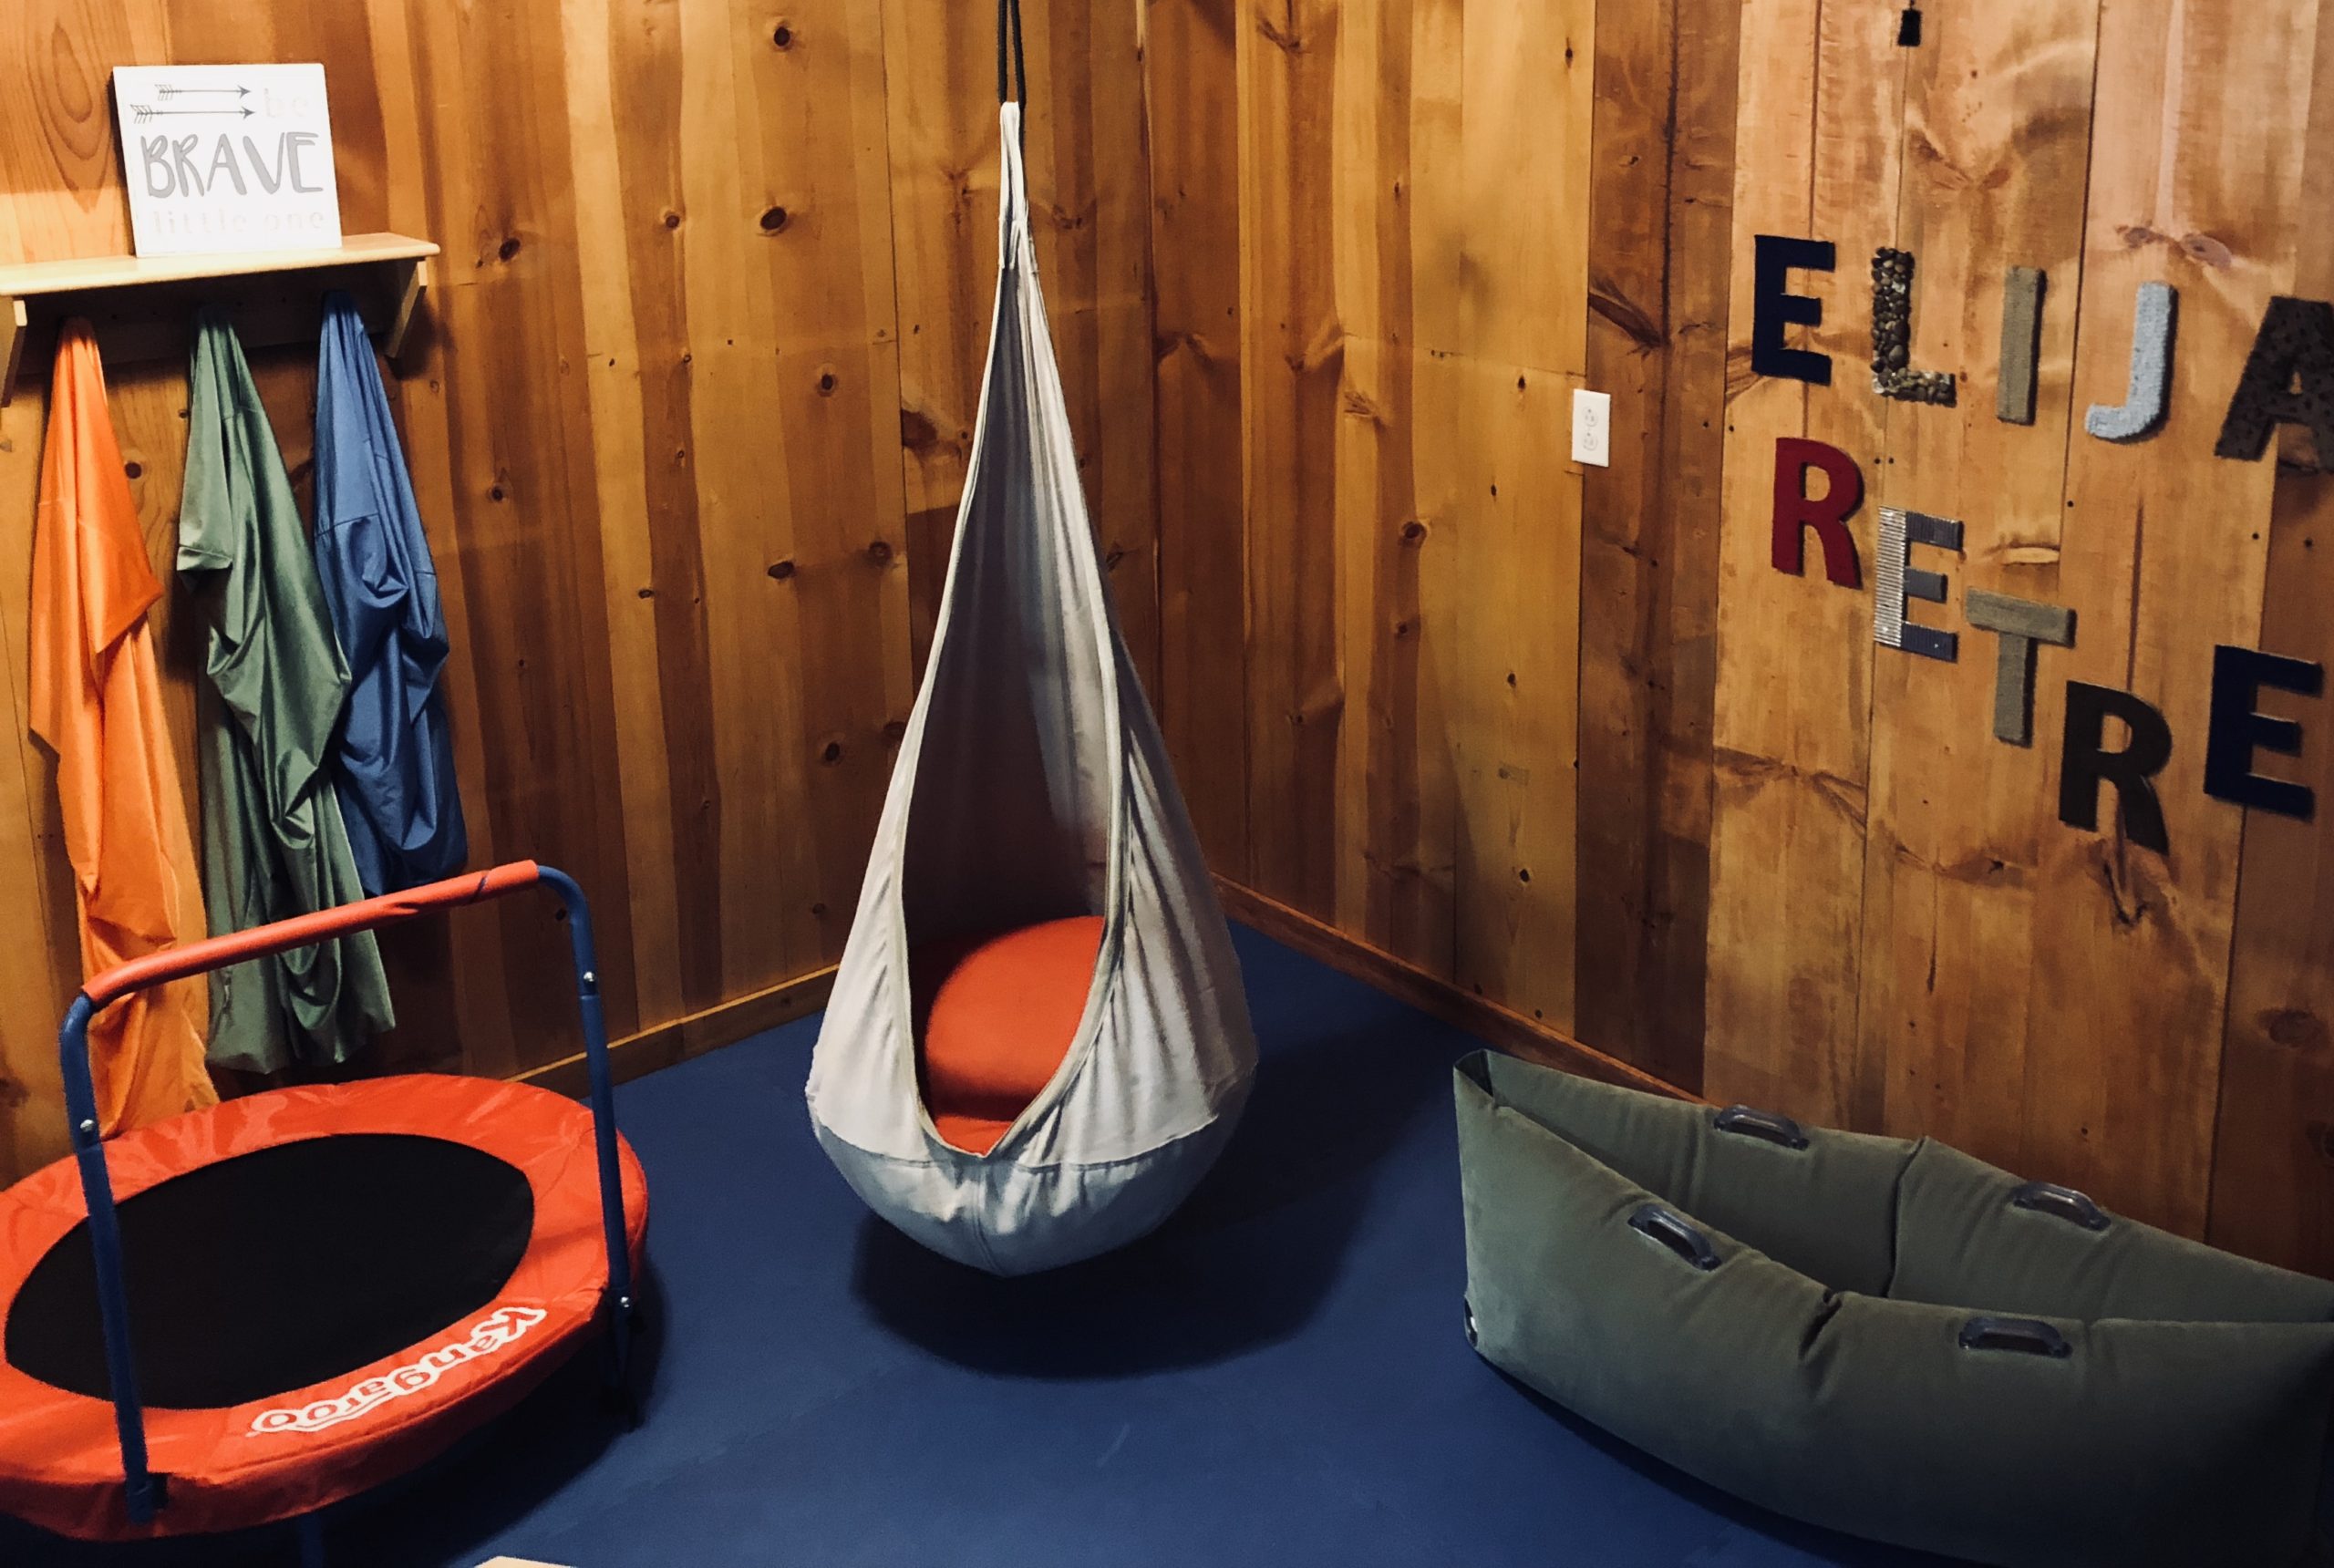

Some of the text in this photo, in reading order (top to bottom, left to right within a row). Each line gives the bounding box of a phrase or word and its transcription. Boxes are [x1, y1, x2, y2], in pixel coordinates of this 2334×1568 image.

[140, 131, 324, 199] BRAVE
[1751, 234, 2334, 471] ELIJA
[1771, 437, 2324, 857] RETRE
[251, 1306, 548, 1432] Kangaroo
